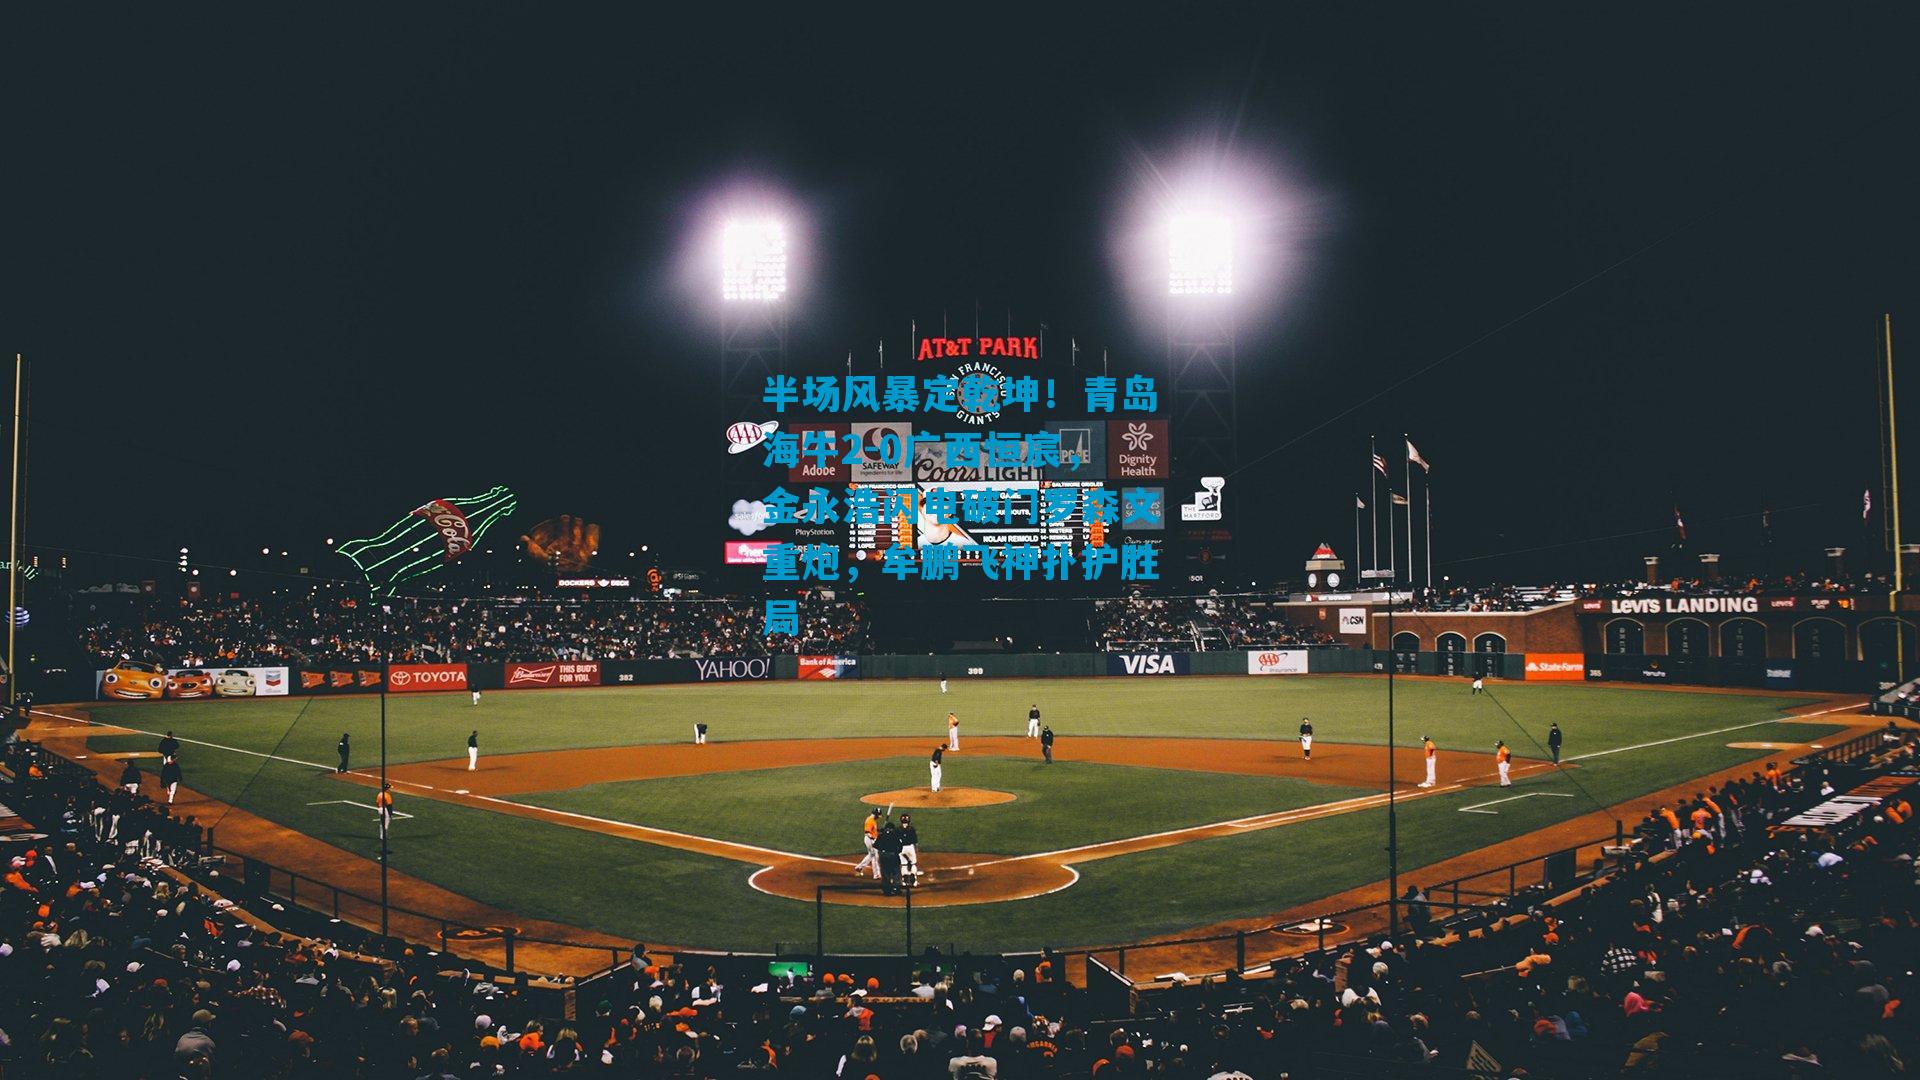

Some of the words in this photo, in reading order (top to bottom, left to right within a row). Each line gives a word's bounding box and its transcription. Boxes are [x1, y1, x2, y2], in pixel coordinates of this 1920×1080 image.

[918, 337, 972, 361] AT&T
[979, 336, 1038, 360] PARK
[956, 409, 1001, 425] GIANTS
[862, 461, 900, 470] SAFEWAY
[1119, 454, 1157, 467] Dignity
[912, 458, 981, 481] Coors
[1121, 466, 1156, 476] Health
[795, 528, 835, 538] PlayStation
[983, 535, 1007, 543] NOLAN
[1008, 535, 1039, 543] REIMOLD
[558, 579, 595, 587] DOCKERS
[610, 579, 630, 587] DECK
[1665, 597, 1759, 613] LANDING
[1349, 615, 1365, 625] CSN
[799, 657, 818, 666] Bank
[818, 657, 827, 666] of
[826, 657, 857, 666] America
[1118, 654, 1176, 675] VISA
[559, 664, 576, 674] THIS
[576, 664, 598, 673] BUD'S
[695, 658, 771, 681] YAHOO!
[413, 670, 467, 684] TOYOTA
[514, 670, 552, 680] Budweiser
[559, 674, 574, 683] FOR
[574, 673, 591, 683] YOU.
